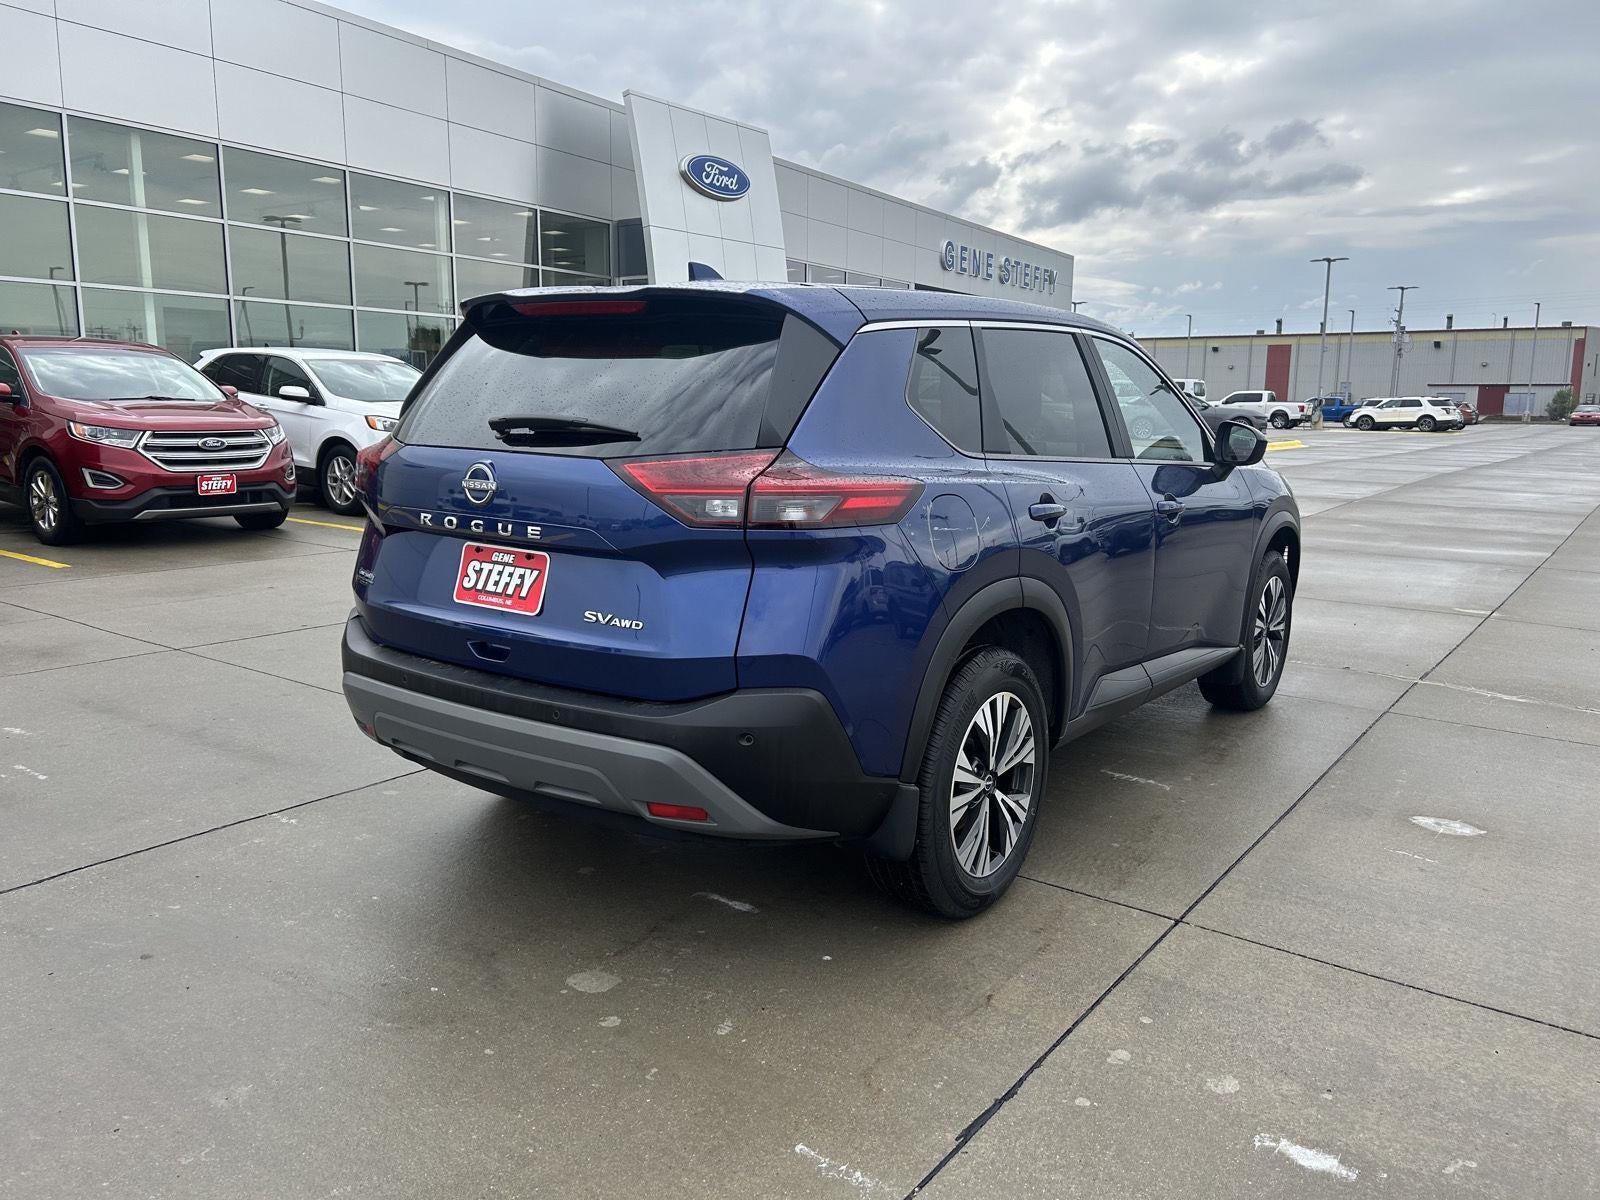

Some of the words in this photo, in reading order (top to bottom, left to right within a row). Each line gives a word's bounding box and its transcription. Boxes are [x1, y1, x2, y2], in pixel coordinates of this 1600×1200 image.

[702, 161, 738, 190] Ford
[942, 240, 994, 280] GENE
[1000, 257, 1058, 294] STEFFY
[202, 480, 232, 490] STEFFY
[462, 480, 496, 490] NISSAN
[420, 512, 542, 540] ROGUE
[491, 551, 515, 564] GENE
[462, 560, 540, 598] STEFFY
[583, 610, 613, 624] SV
[610, 617, 644, 630] AWD
